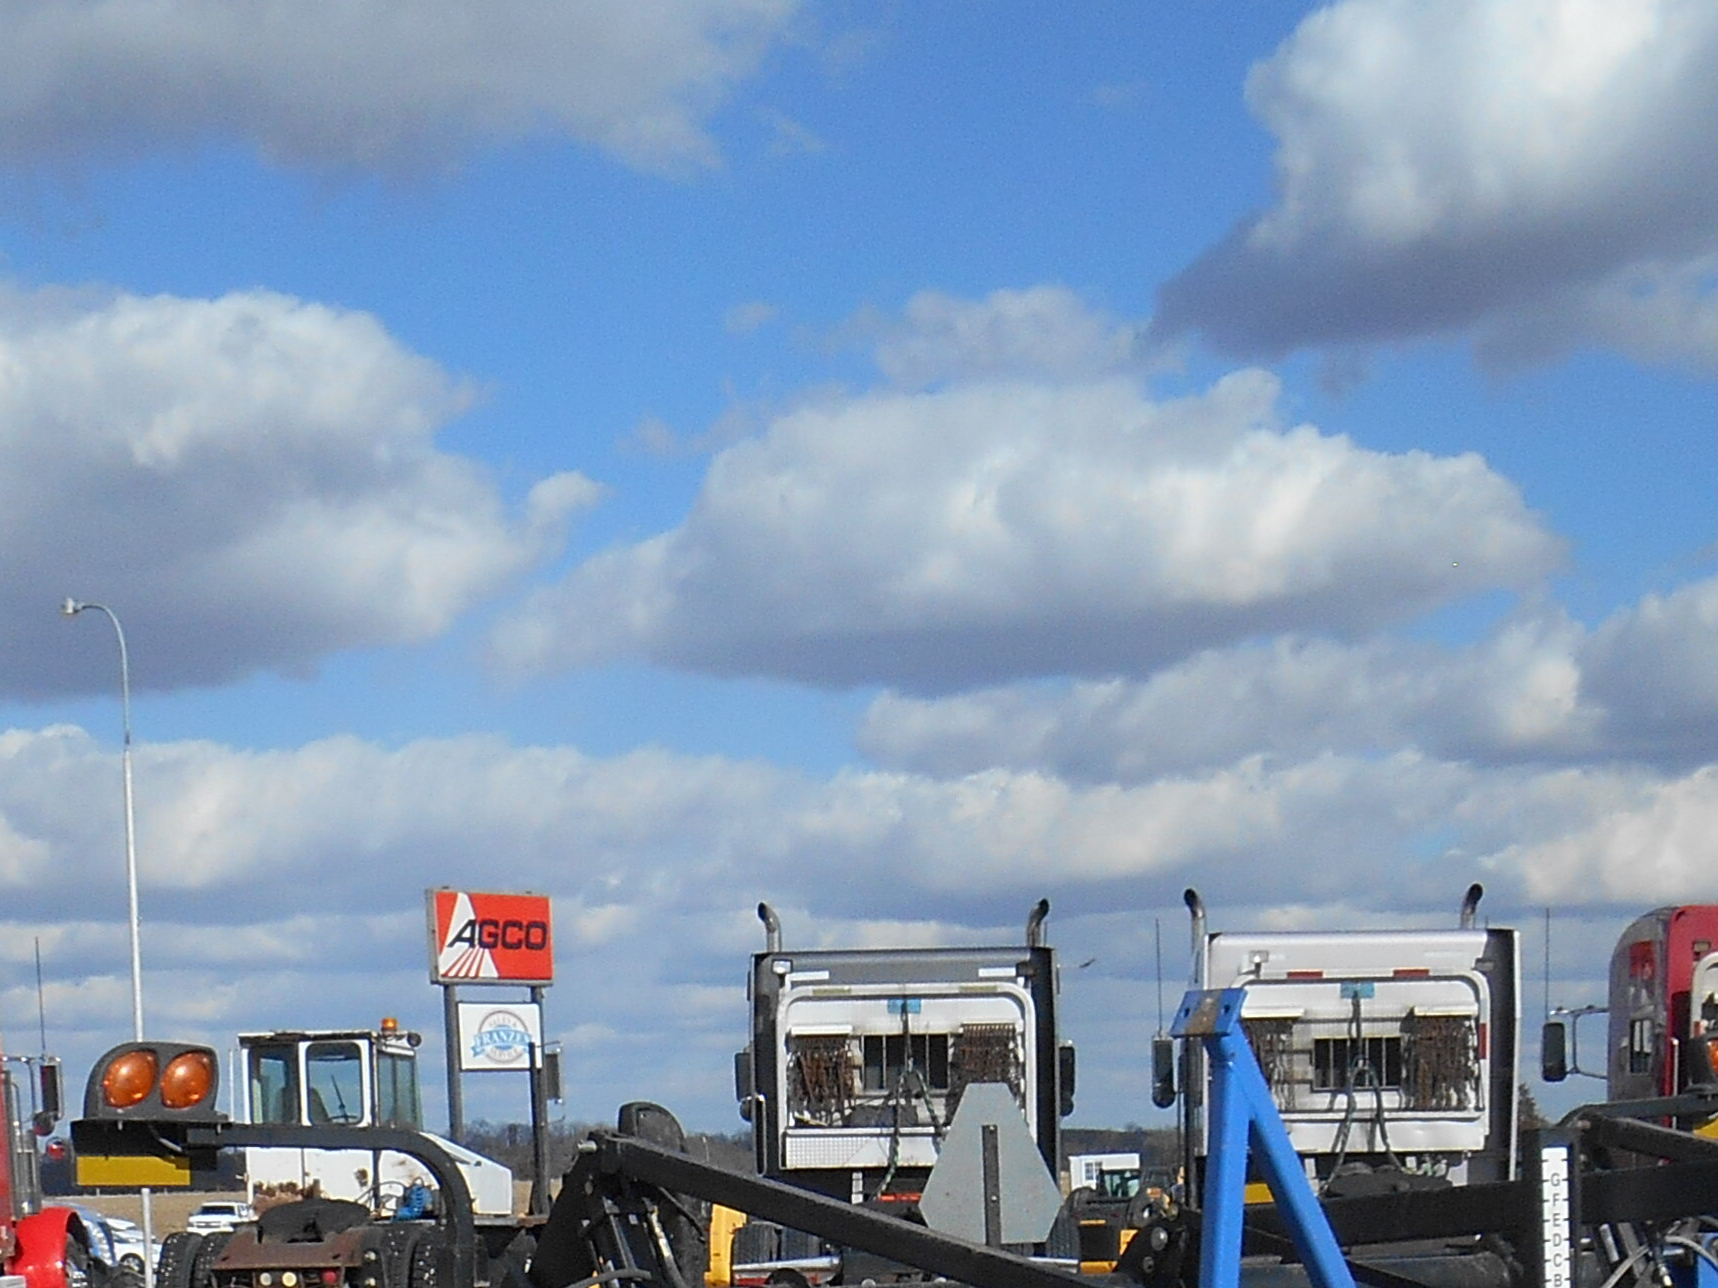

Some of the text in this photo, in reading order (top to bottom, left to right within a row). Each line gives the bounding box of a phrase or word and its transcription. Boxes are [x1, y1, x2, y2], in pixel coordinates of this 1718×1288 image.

[446, 919, 547, 950] AGCO
[1550, 1172, 1561, 1187] G
[1552, 1192, 1560, 1206] F
[1553, 1213, 1561, 1227] E
[1553, 1233, 1562, 1247] D
[1553, 1253, 1563, 1268] C
[1553, 1274, 1563, 1288] B
